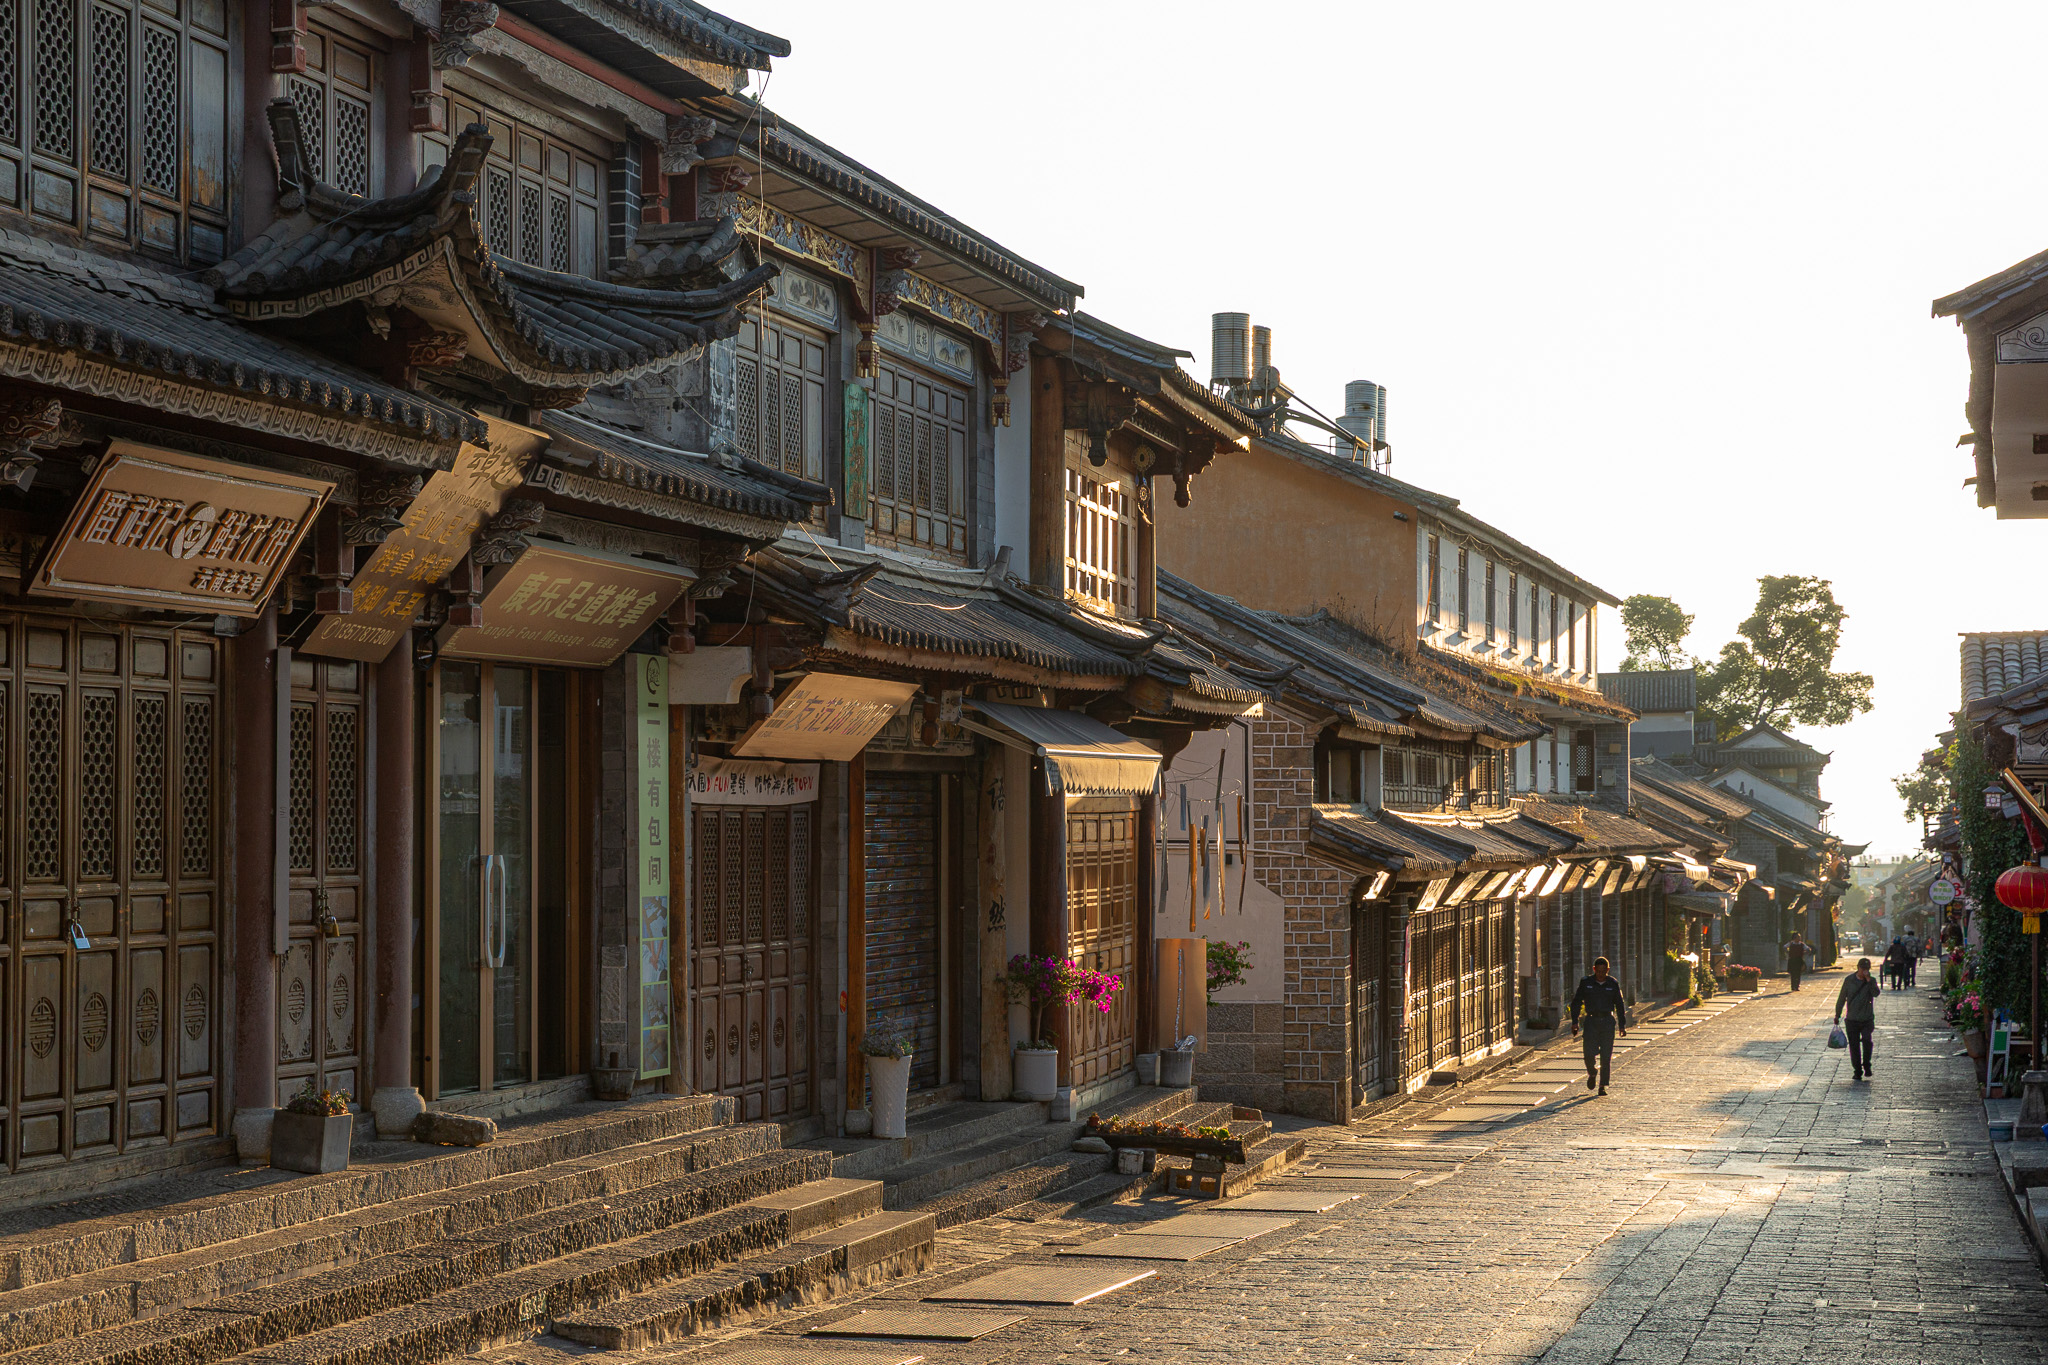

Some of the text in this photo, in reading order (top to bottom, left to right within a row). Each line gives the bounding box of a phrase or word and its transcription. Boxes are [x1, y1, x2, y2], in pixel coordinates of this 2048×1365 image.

[434, 484, 491, 511] Foot massage
[203, 509, 298, 567] 鲜花饼
[402, 505, 481, 549] 专业足疗
[192, 566, 265, 597] 云南老字号
[370, 543, 454, 585] 推拿 拔罐
[352, 580, 426, 621] 修脚 采耳
[499, 570, 658, 629] 康乐足道推拿
[334, 622, 396, 647] 13577877300
[477, 622, 516, 640] Kangle
[517, 627, 540, 640] Foot
[543, 630, 585, 647] Massage
[646, 701, 662, 886] 二楼有包间
